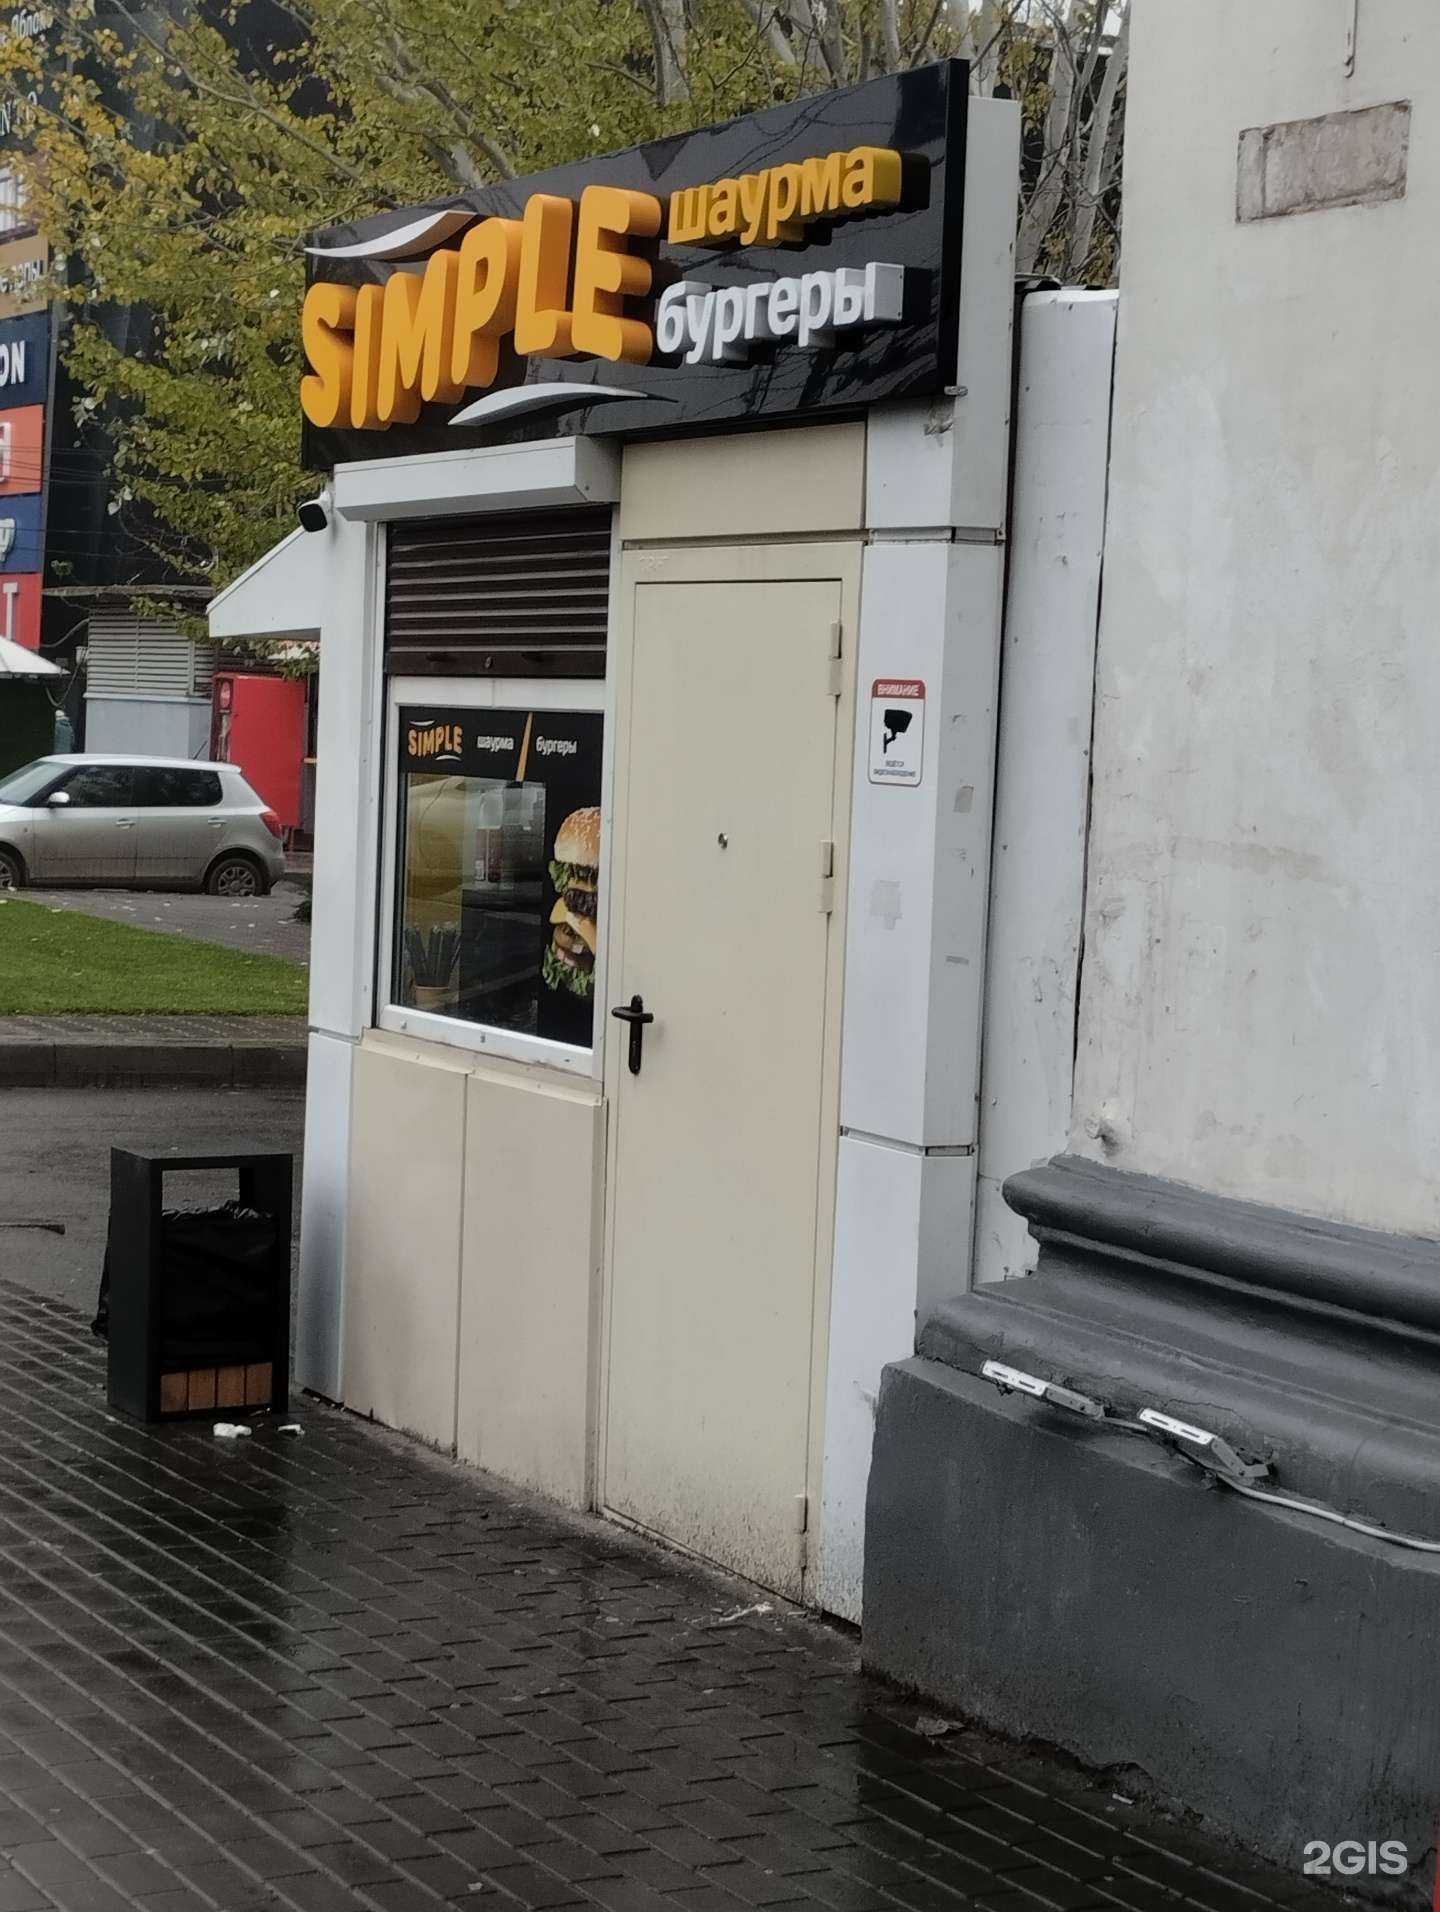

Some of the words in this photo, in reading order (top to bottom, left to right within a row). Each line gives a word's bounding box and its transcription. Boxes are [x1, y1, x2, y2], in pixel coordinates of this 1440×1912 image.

[668, 146, 902, 249] шаурма
[300, 185, 662, 431] SIMPLE
[656, 262, 905, 365] бургеры
[408, 724, 463, 757] SIMPLE
[477, 735, 514, 753] шаурма
[536, 735, 578, 756] бургеры
